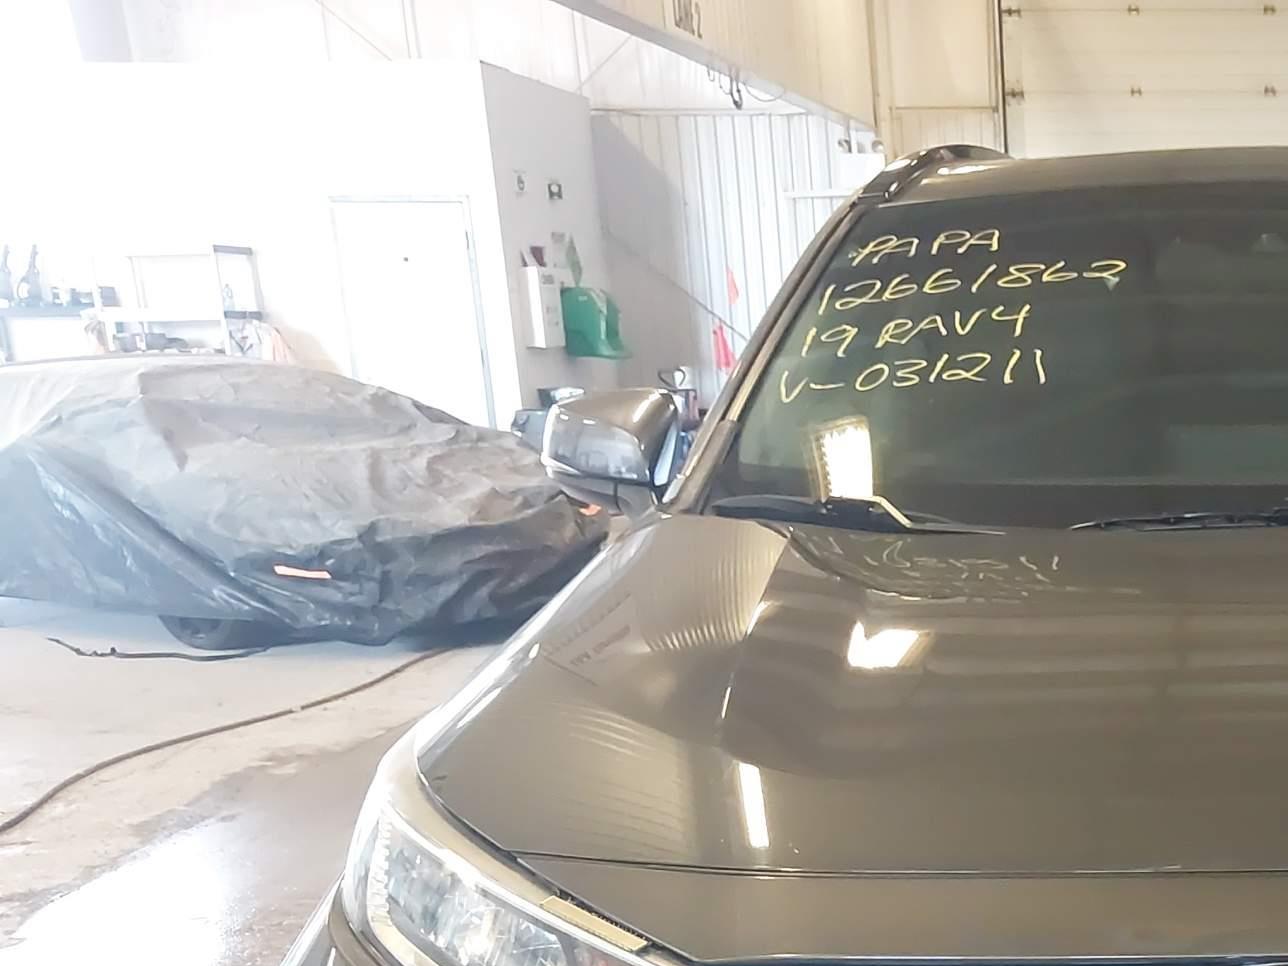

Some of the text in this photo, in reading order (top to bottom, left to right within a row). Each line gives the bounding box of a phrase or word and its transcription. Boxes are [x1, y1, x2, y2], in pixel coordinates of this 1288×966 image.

[818, 260, 1127, 316] 12661862
[801, 304, 1031, 357] 19 RAV4
